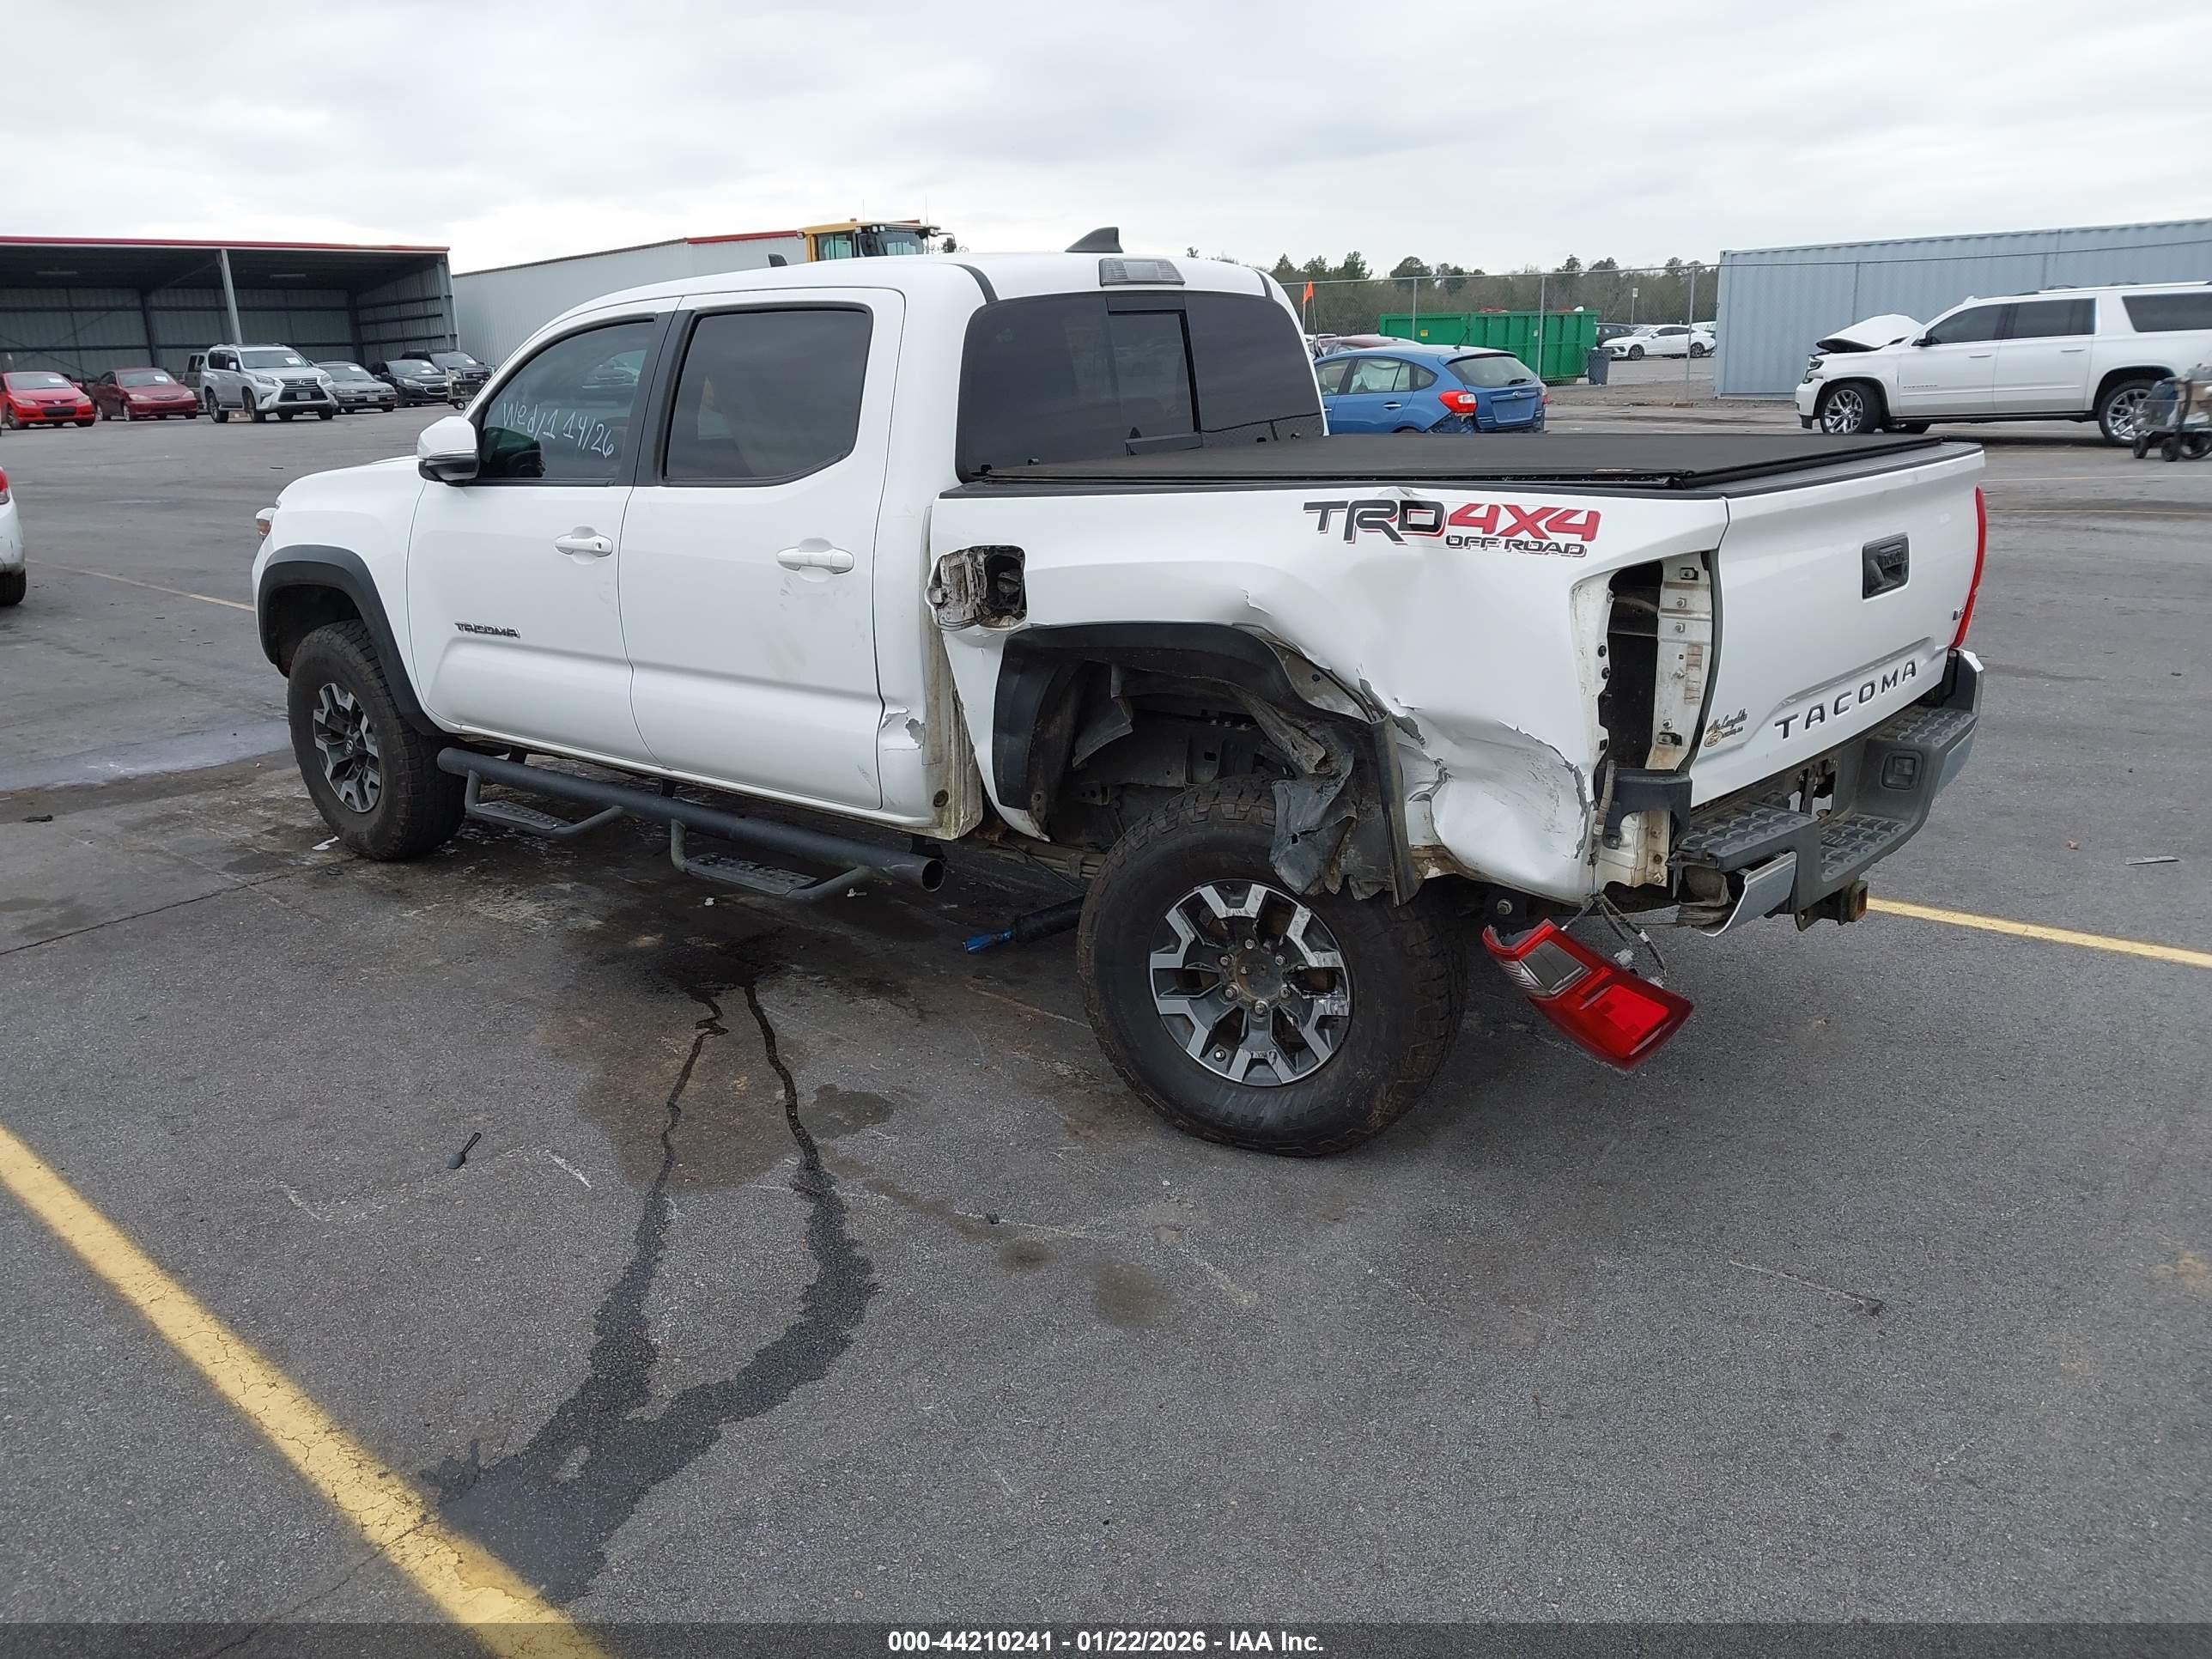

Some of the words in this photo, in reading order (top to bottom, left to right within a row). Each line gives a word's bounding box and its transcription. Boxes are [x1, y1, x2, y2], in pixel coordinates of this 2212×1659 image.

[1303, 499, 1448, 545] TRD
[1445, 535, 1501, 550] OFF
[1503, 538, 1589, 558] ROAD
[454, 621, 522, 640] TACOMA
[1774, 659, 1917, 740] TACOMA
